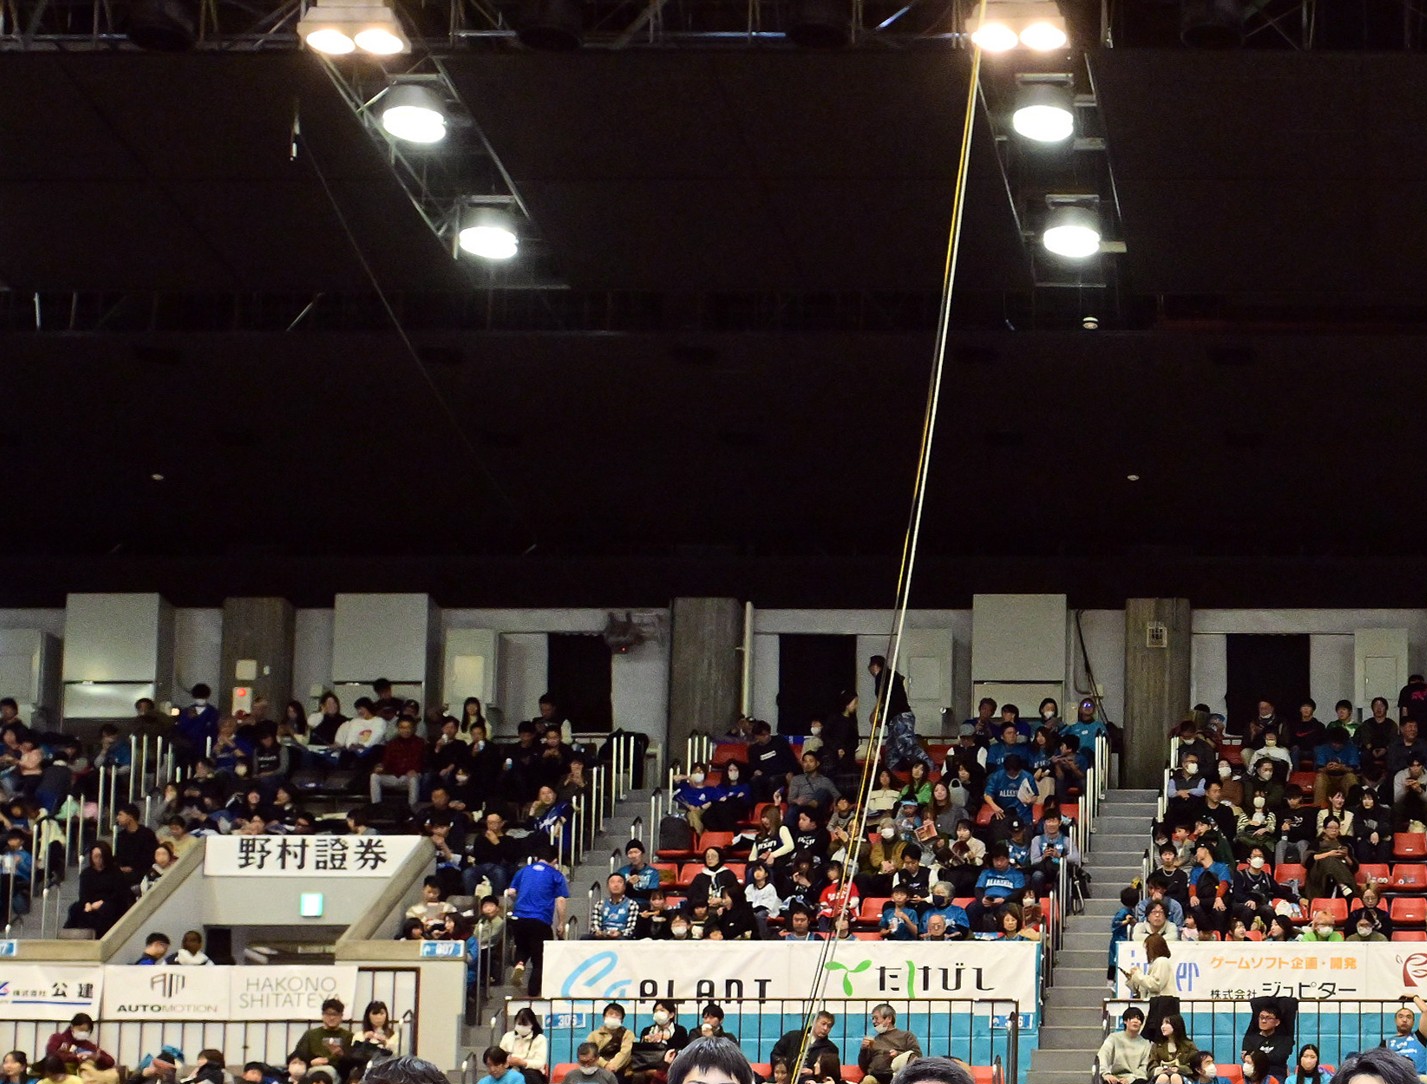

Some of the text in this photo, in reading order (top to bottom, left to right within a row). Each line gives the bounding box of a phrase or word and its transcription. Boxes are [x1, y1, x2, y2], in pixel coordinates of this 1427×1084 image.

[237, 837, 388, 870] 野村證券
[1210, 957, 1358, 971] ゲームソフト企画・開発
[246, 977, 337, 992] HAKONO
[116, 1004, 218, 1014] AUTOMOTION
